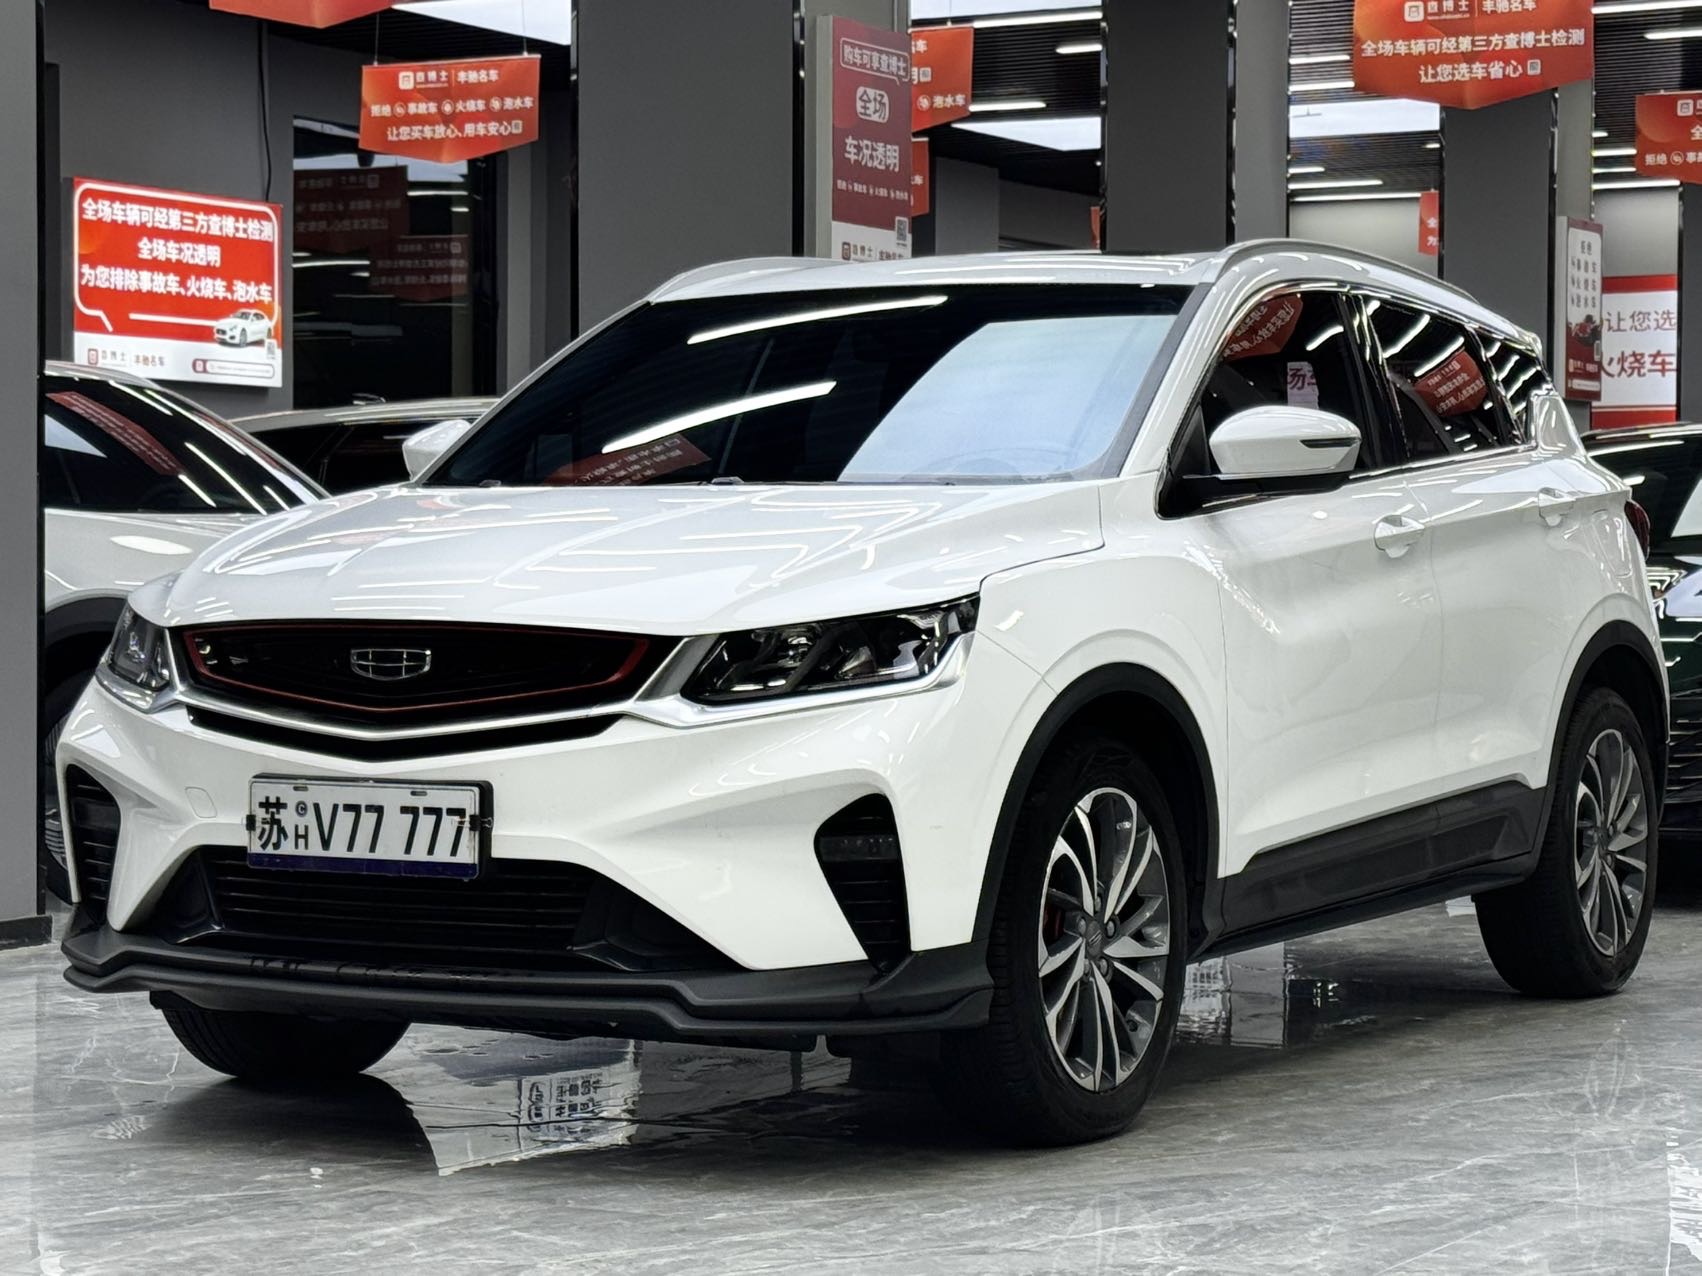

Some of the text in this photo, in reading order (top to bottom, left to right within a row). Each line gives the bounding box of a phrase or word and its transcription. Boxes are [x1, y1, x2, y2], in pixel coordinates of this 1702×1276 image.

[1361, 28, 1586, 58] 全场车辆可经第三方查博士检测
[843, 44, 908, 77] 购车可享查博士
[1418, 61, 1523, 84] 让您选车省心
[858, 91, 888, 121] 全场
[387, 121, 512, 142] 让您买车放心、用车安心
[844, 135, 900, 173] 车况透明
[82, 198, 274, 243] 全场车辆可经第三方查博士检测
[137, 236, 222, 268] 全场车况透明
[80, 264, 273, 304] 为您排除事故车、火烧车、泡水车
